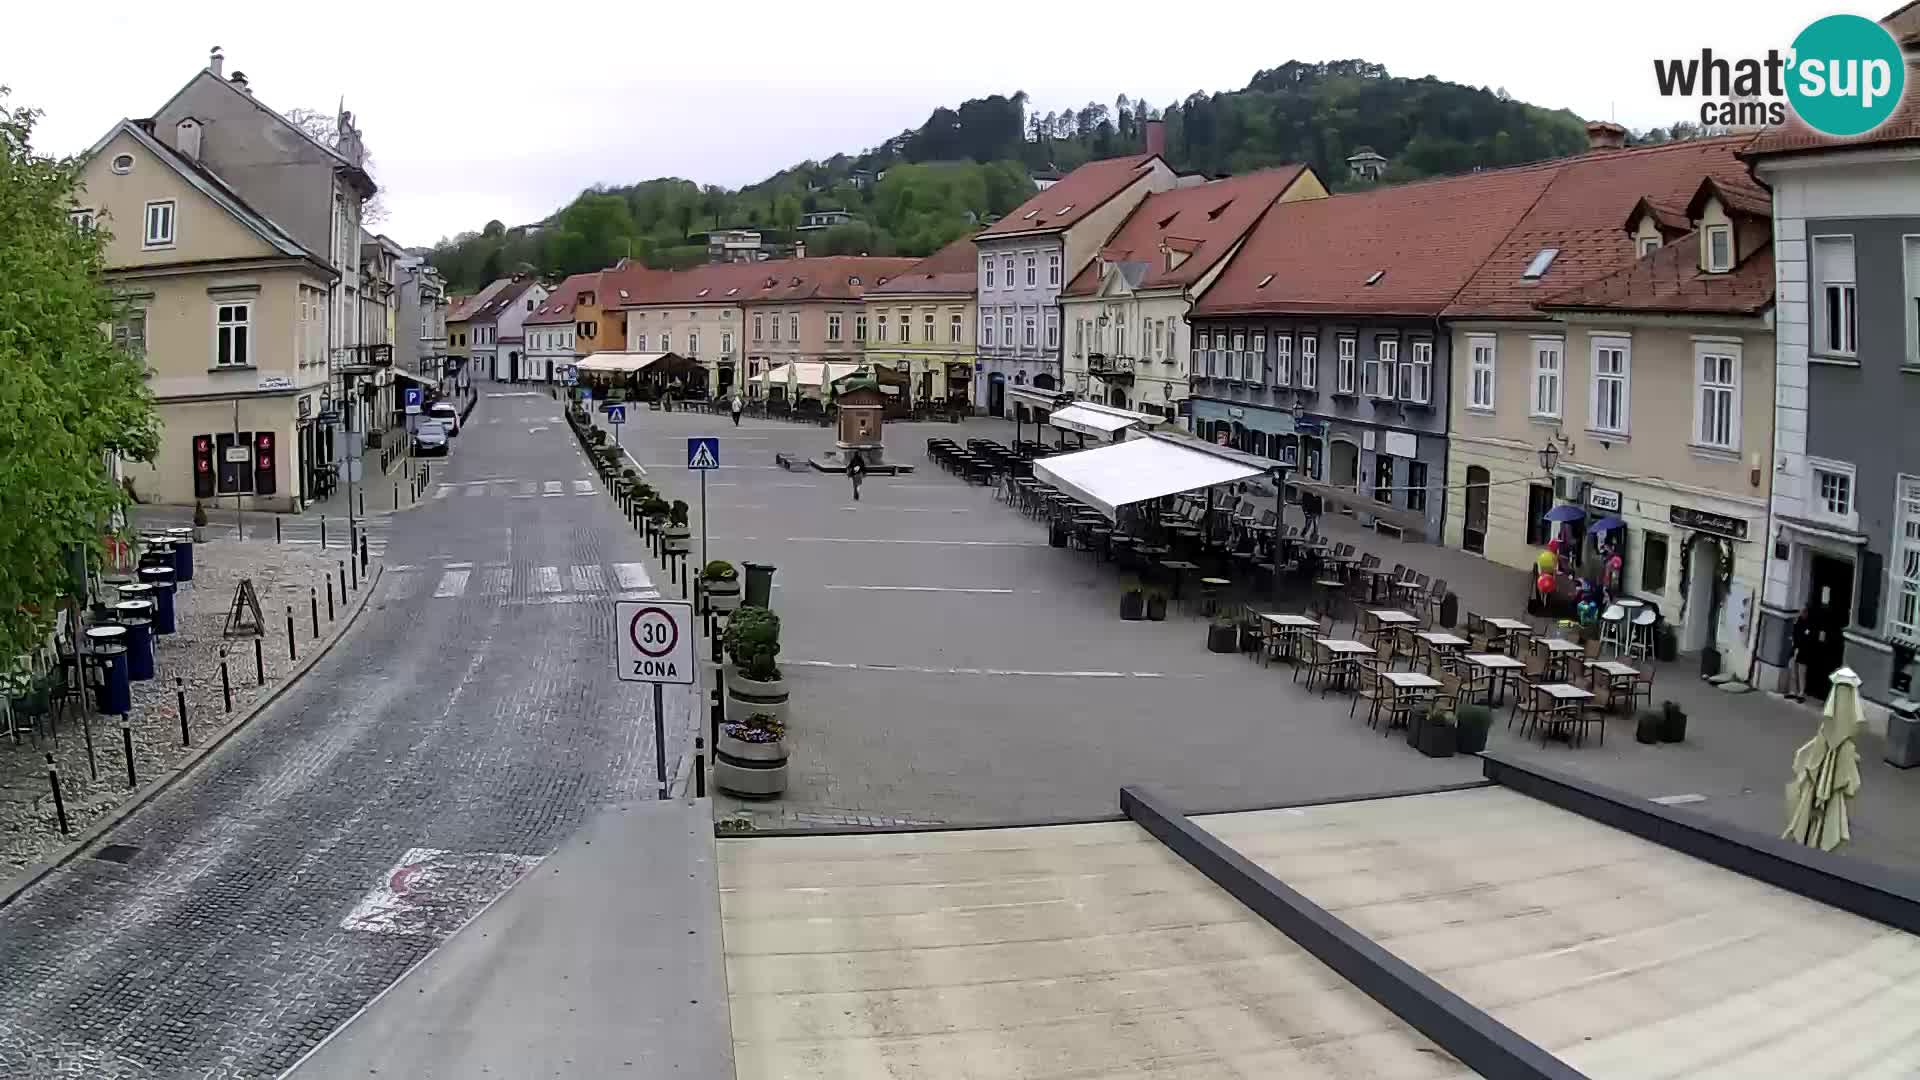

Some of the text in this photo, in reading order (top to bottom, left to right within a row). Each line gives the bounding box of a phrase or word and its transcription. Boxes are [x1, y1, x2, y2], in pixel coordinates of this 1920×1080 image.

[409, 391, 417, 403] P
[643, 623, 667, 645] 30
[633, 660, 678, 677] ZONA
